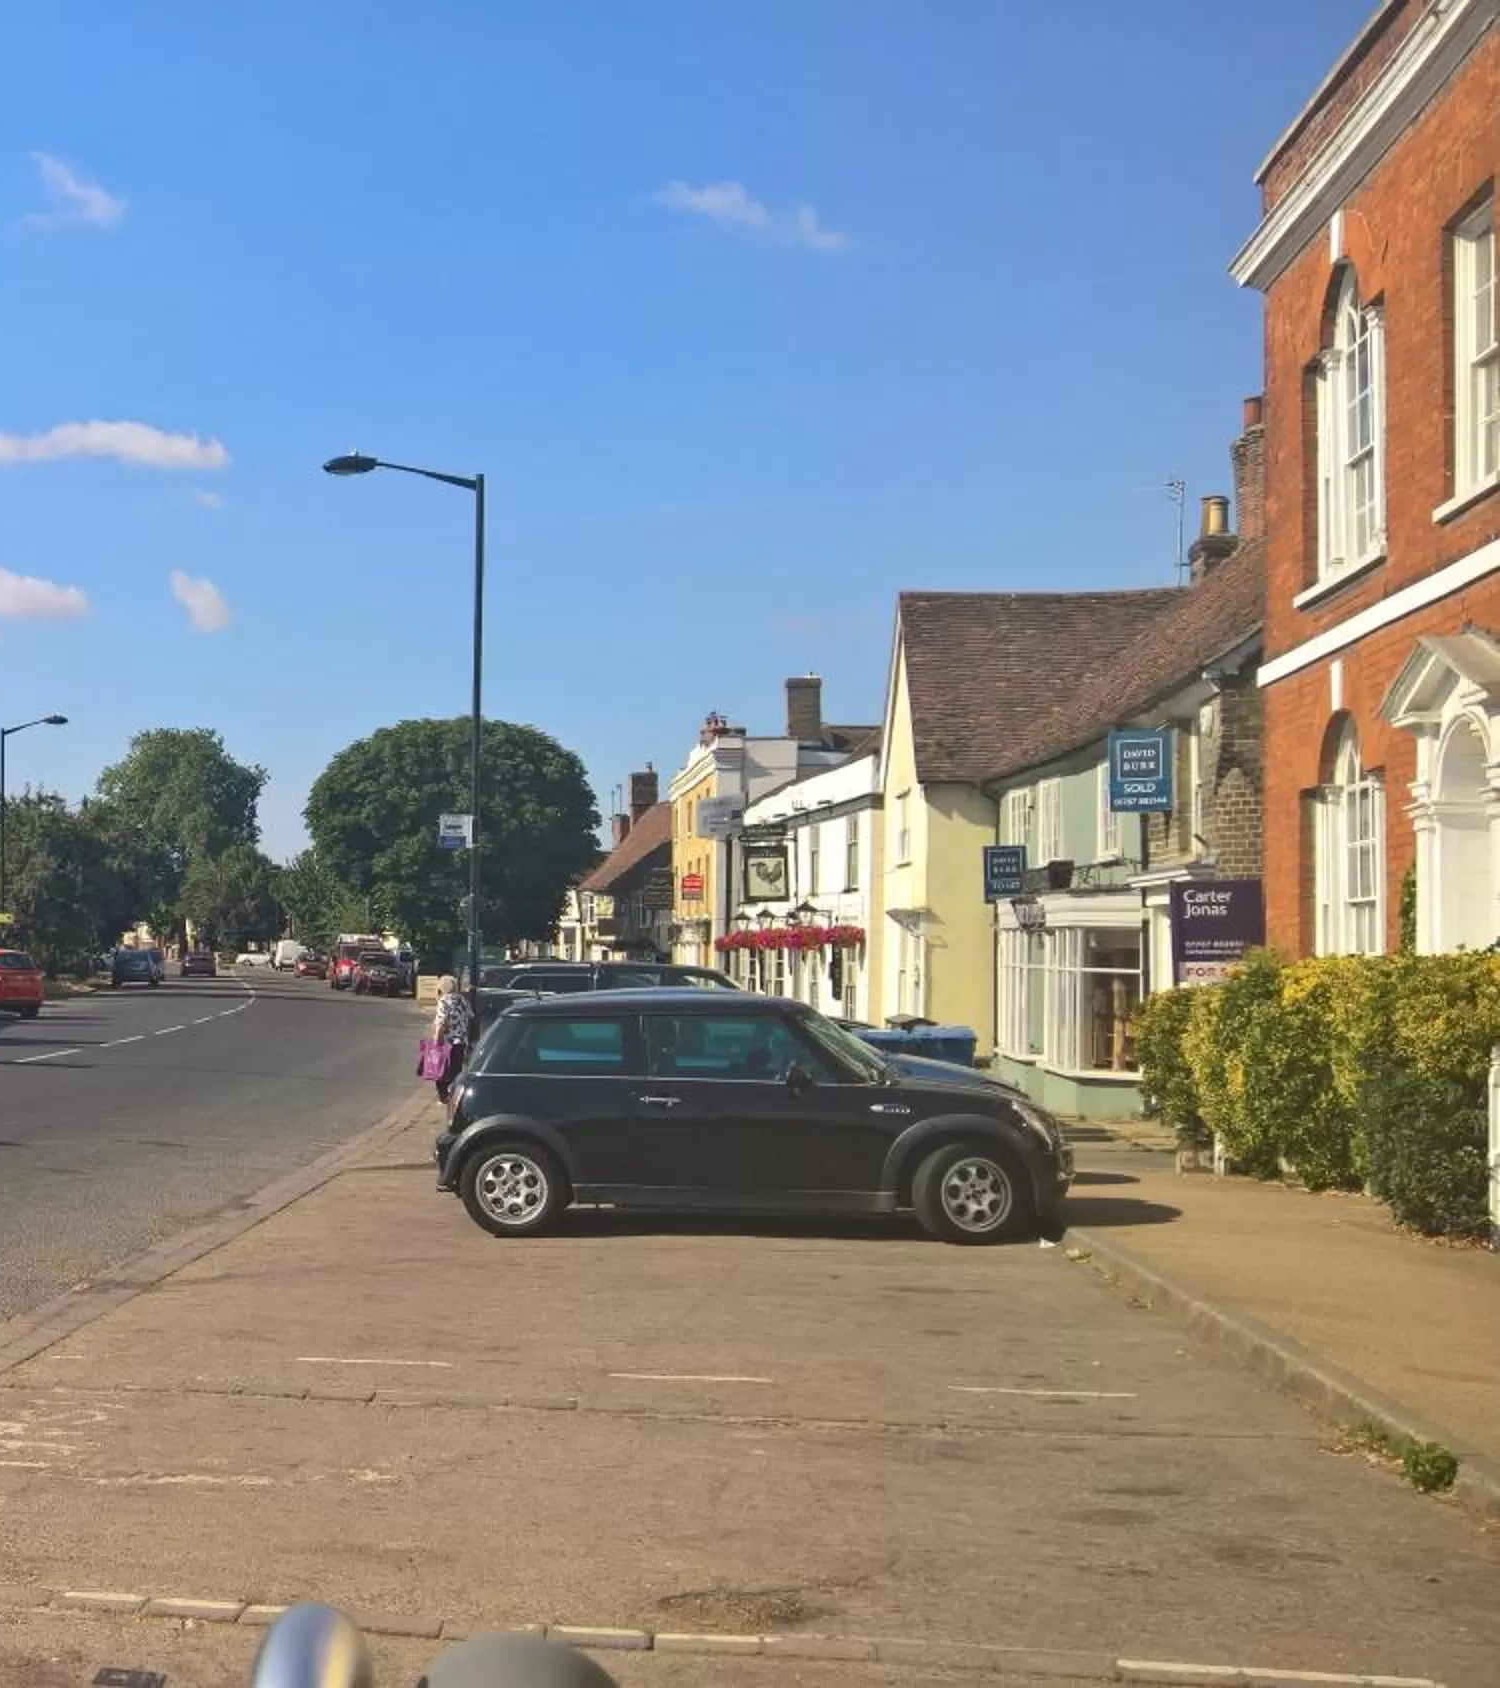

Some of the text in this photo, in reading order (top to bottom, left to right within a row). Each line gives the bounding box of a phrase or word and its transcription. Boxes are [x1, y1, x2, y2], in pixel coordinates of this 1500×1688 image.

[1123, 748, 1157, 759] DAVID
[1123, 783, 1156, 795] SOLD
[1183, 889, 1233, 903] Carter
[1183, 903, 1228, 919] Jonas
[1187, 967, 1215, 977] FOR
